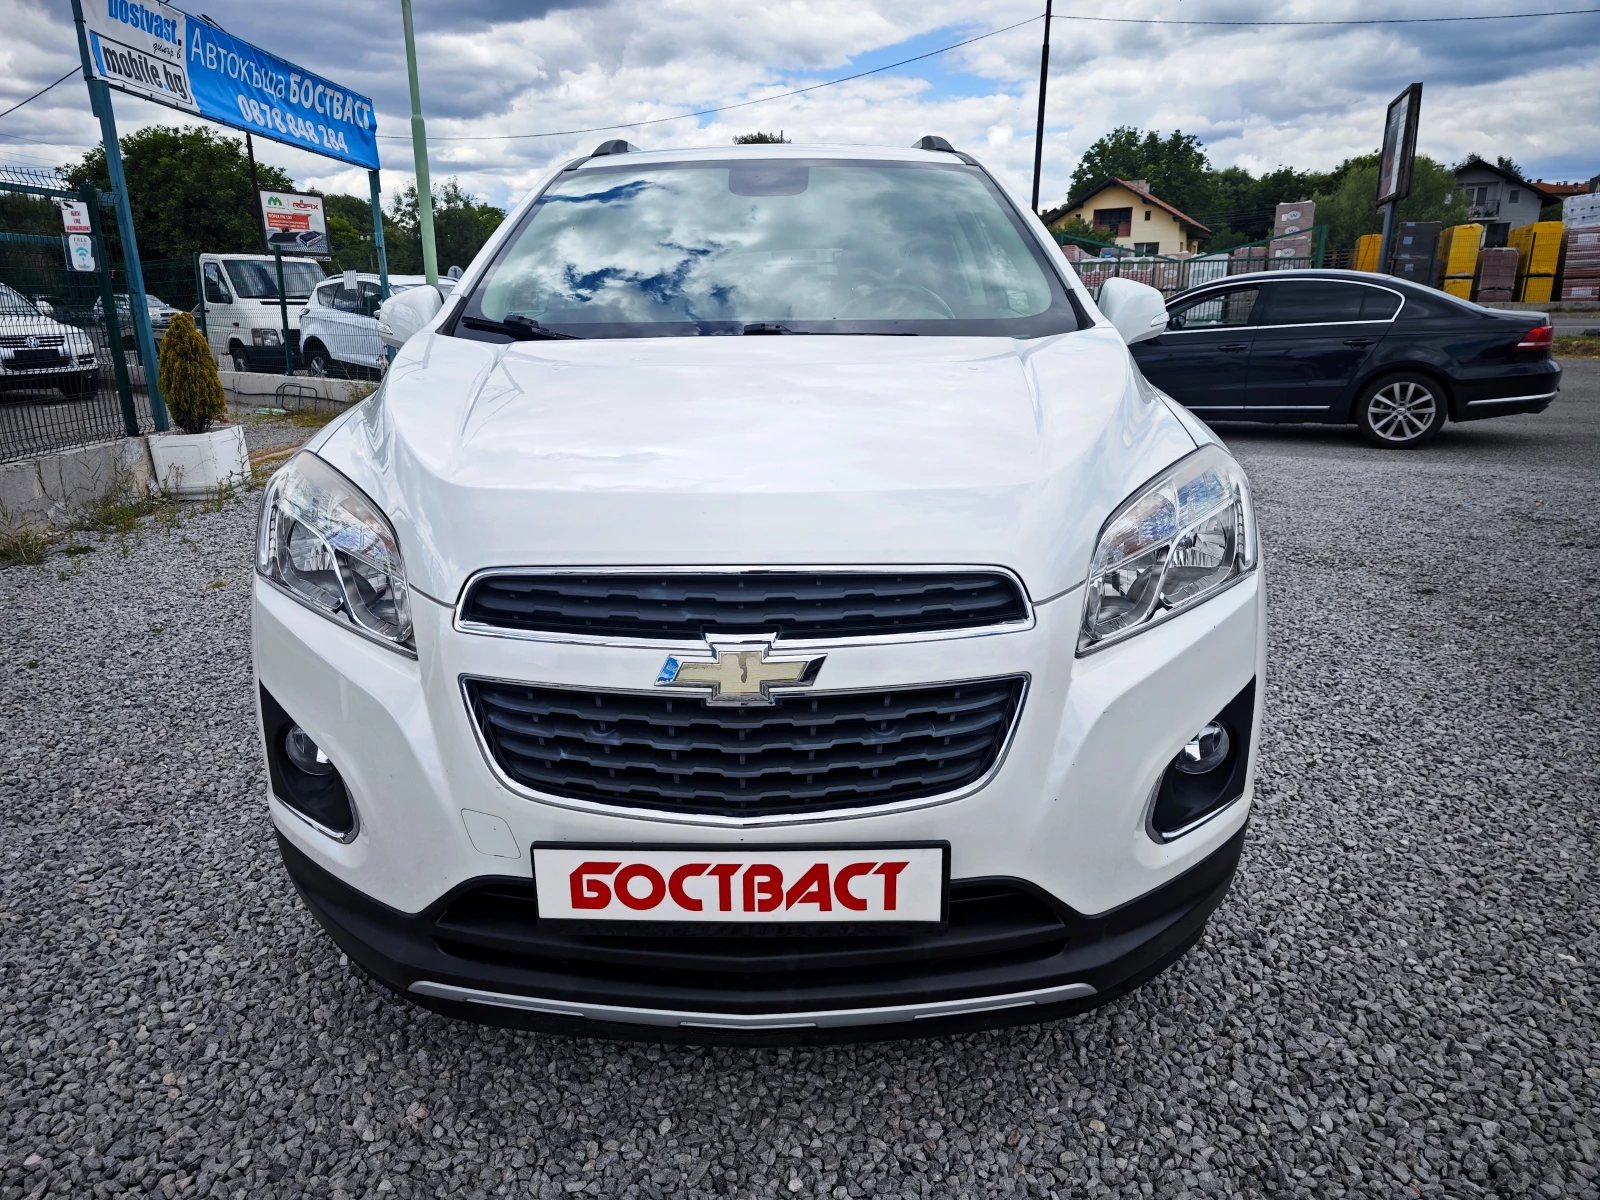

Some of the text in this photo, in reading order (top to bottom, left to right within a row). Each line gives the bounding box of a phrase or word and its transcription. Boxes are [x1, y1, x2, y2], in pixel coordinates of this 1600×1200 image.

[102, 45, 188, 100] mobile.bg
[237, 94, 349, 154] 0878 848 284
[289, 72, 371, 130] БОСТВАСТ
[569, 861, 911, 913] БОСТВАСТ
